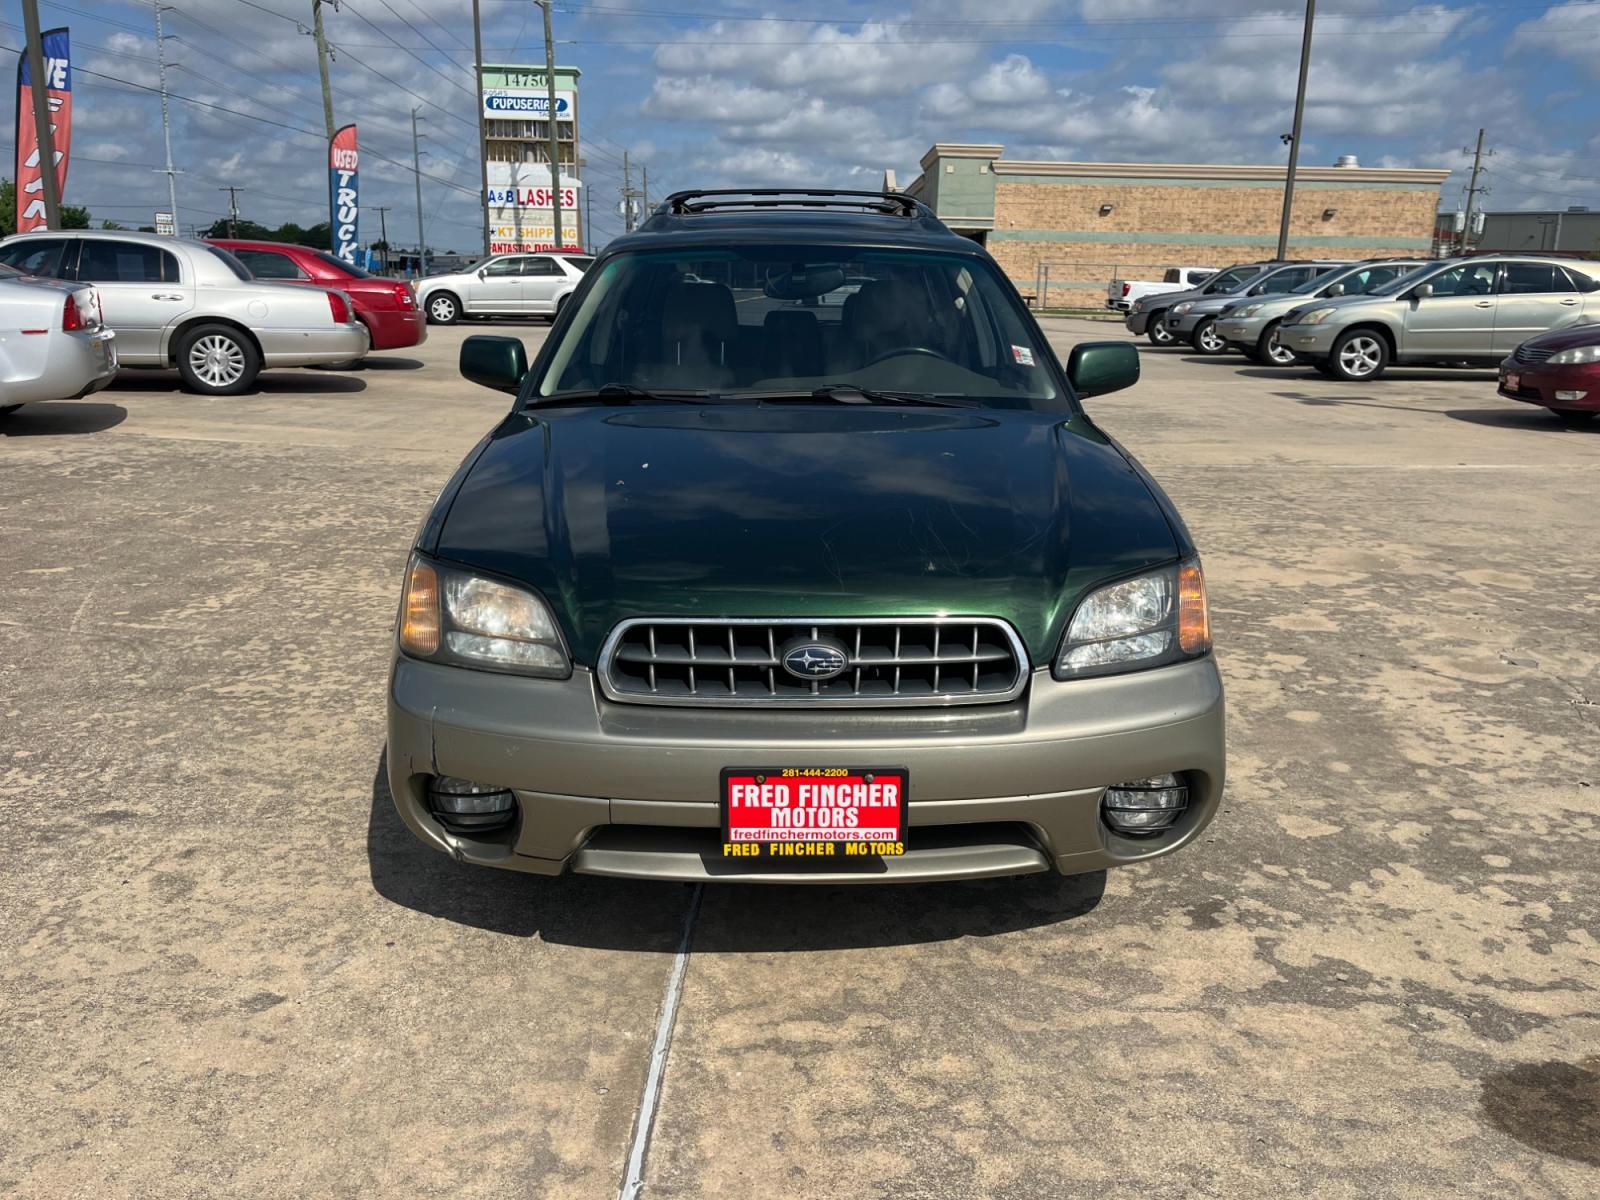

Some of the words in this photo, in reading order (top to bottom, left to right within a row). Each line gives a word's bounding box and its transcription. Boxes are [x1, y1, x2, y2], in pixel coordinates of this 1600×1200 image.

[504, 73, 549, 87] 14750
[492, 98, 550, 110] PUPUSERIA
[334, 148, 358, 169] USED
[488, 190, 496, 203] A
[498, 192, 504, 201] &
[506, 190, 514, 203] B
[516, 188, 574, 207] LASHES
[337, 170, 358, 264] TRUCK
[497, 227, 514, 237] KT
[518, 227, 577, 239] SHIPPNG
[490, 242, 532, 254] ANTASTIC
[782, 768, 849, 777] 281-444-2200
[731, 784, 790, 808] FRED
[798, 784, 898, 808] FINCHER
[770, 807, 859, 828] MOTORS
[733, 829, 894, 840] fredfinchermotors.com
[723, 843, 760, 856] FRED
[769, 842, 835, 856] FINCHER
[845, 842, 904, 856] MOTORS
